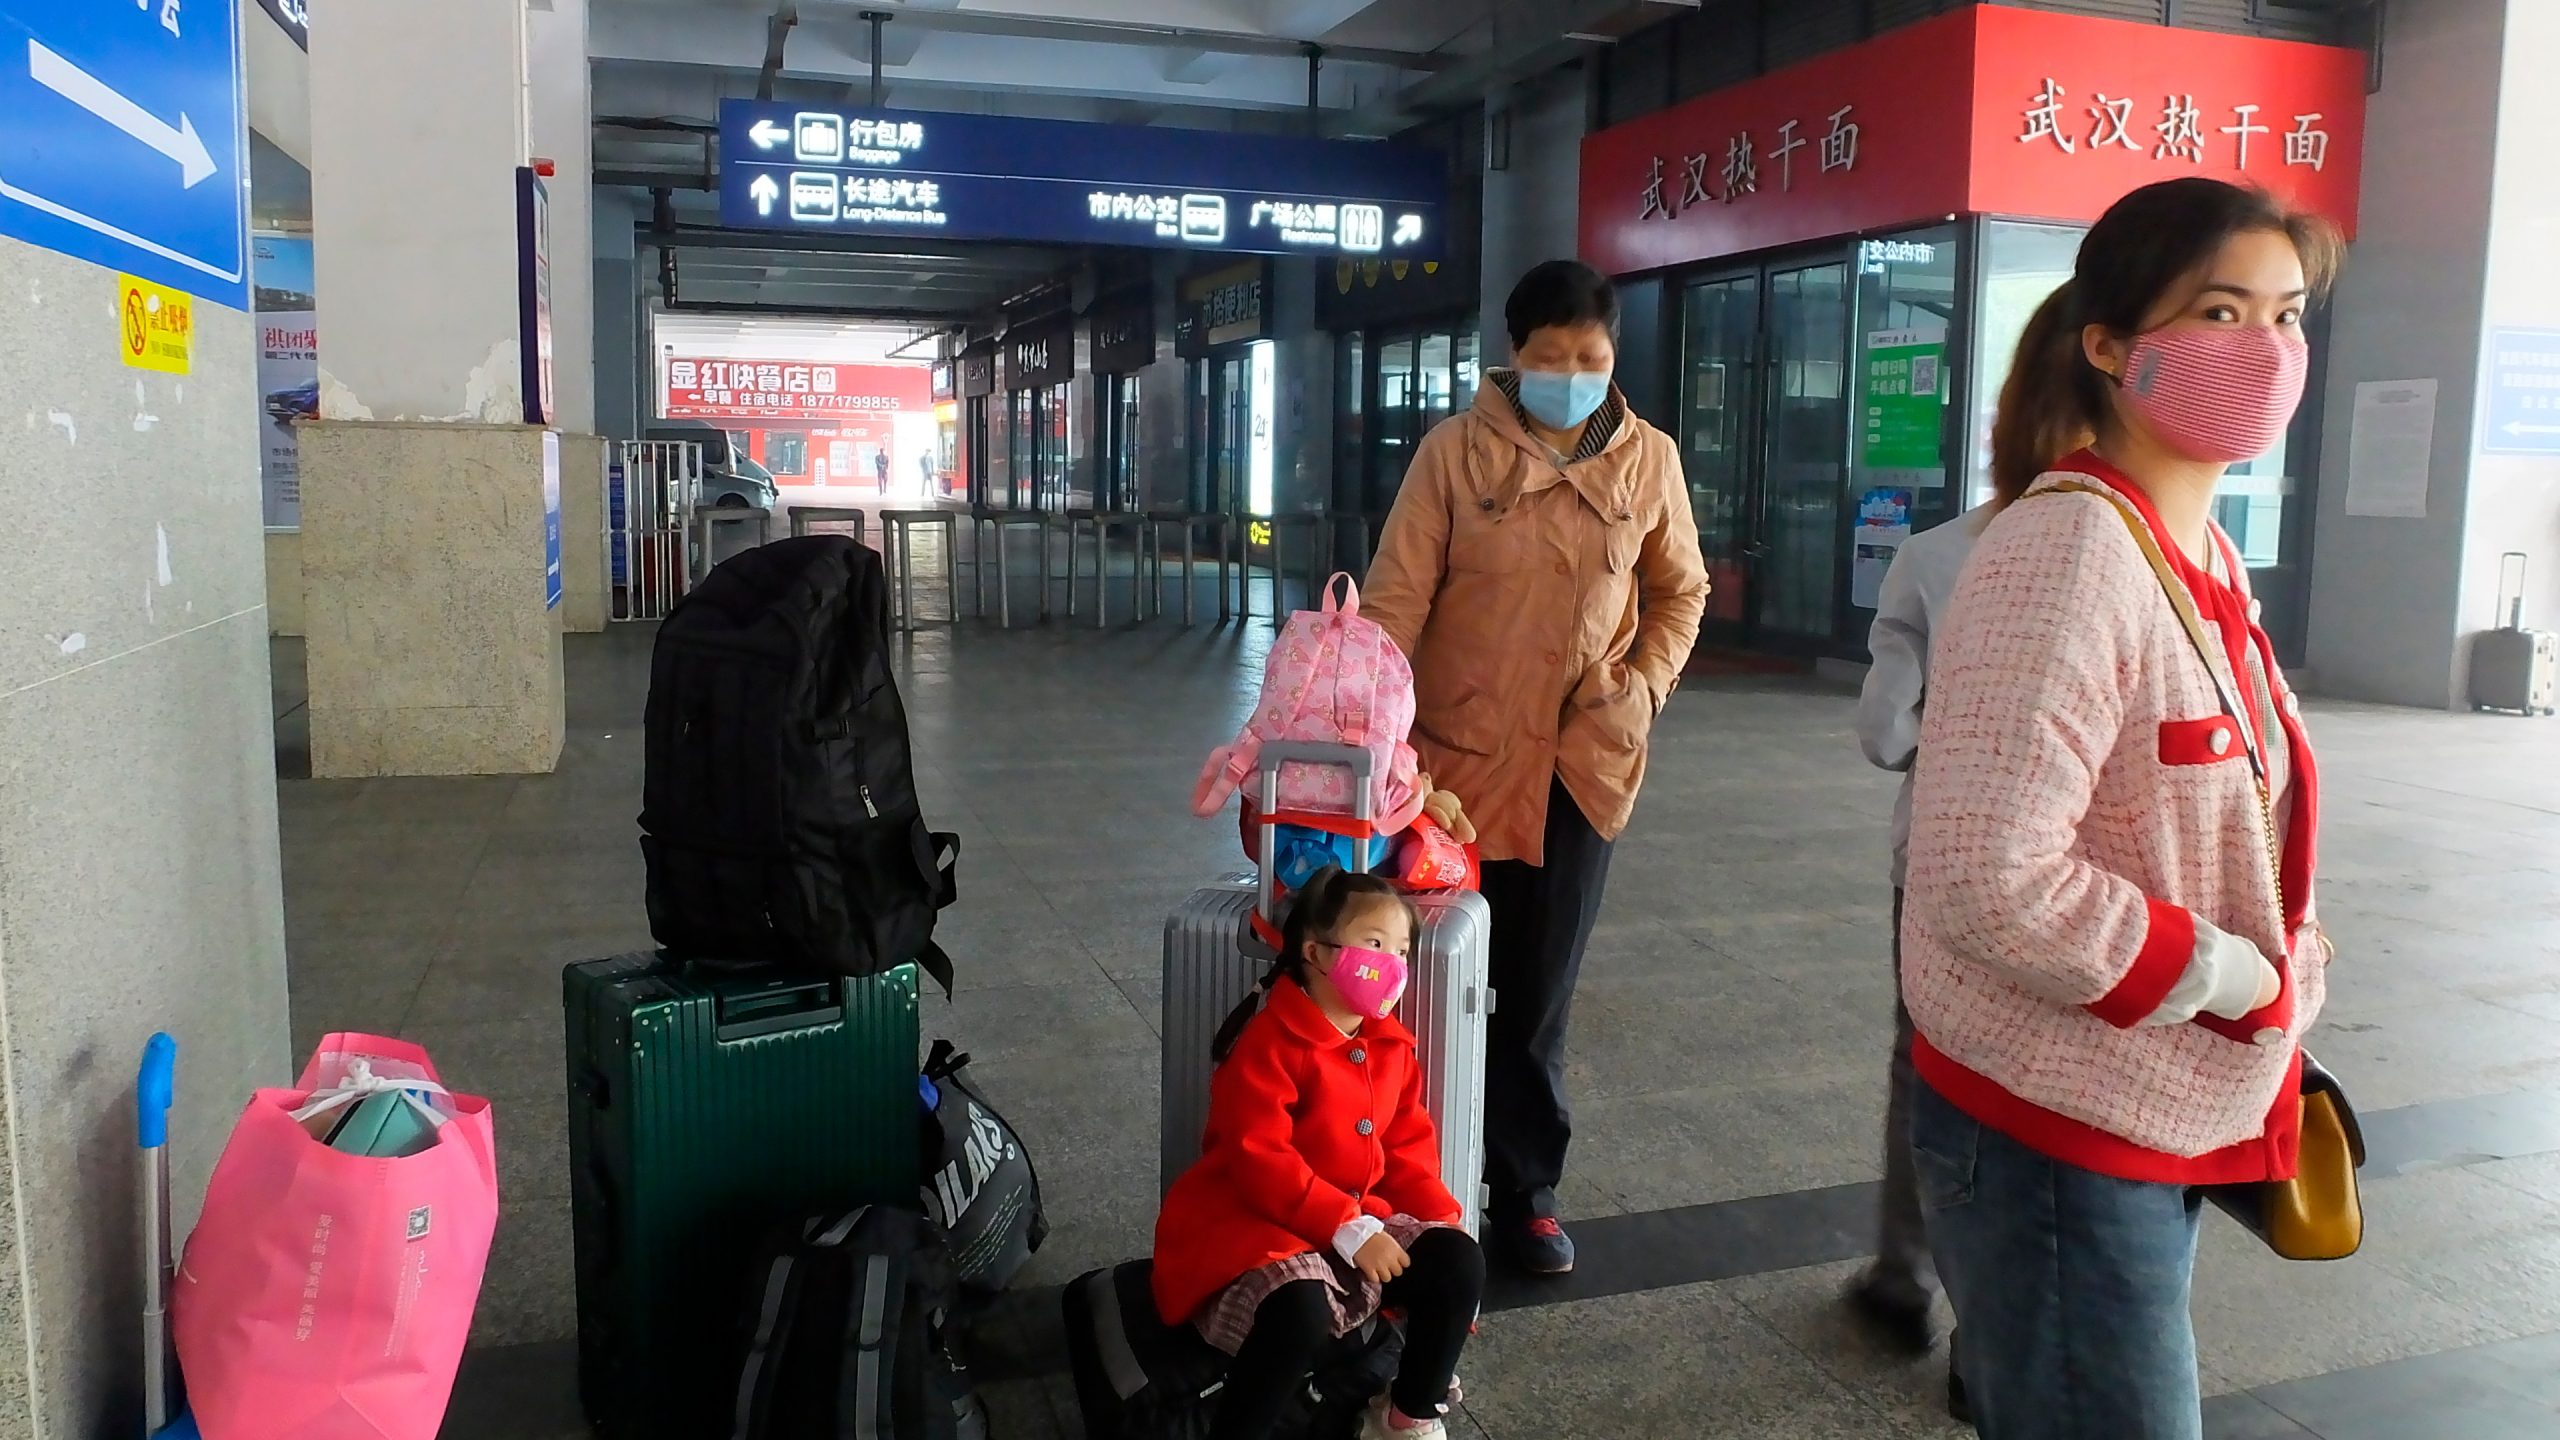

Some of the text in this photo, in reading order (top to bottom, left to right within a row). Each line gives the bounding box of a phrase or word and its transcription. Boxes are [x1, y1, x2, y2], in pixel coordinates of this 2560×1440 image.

[850, 118, 923, 149] 行包房
[2018, 77, 2329, 172] 武汉热干面
[1639, 105, 1859, 220] 武汉热干面
[843, 176, 939, 207] 长途汽车
[1089, 191, 1178, 221] 市内公交
[923, 210, 947, 224] Bus
[1156, 221, 1179, 236] Bus
[671, 361, 810, 393] 显红快餐店
[740, 392, 793, 407] 住宿电话
[800, 394, 900, 409] 18771799855
